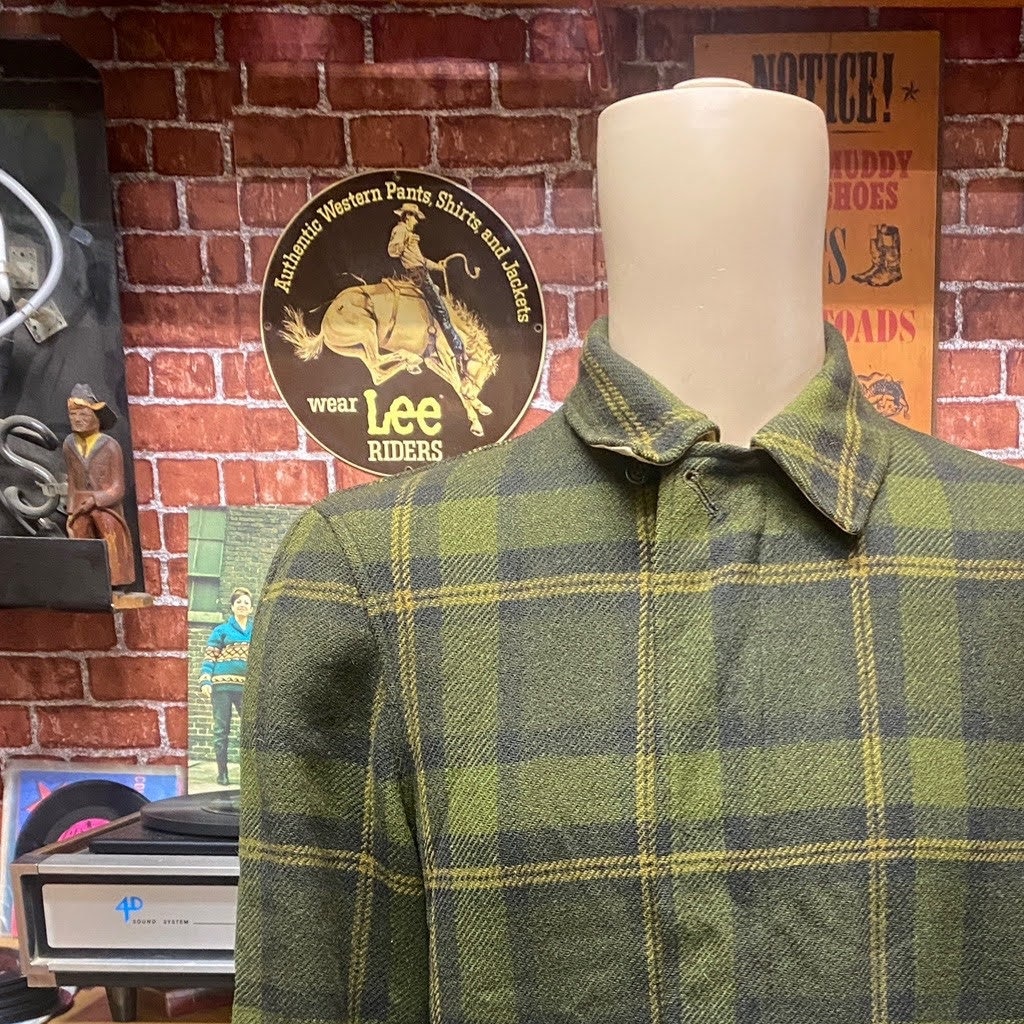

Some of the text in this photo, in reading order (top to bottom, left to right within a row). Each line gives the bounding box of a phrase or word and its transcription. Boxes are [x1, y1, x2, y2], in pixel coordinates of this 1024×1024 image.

[752, 51, 895, 124] NOTICE!
[828, 181, 899, 211] HOES
[273, 180, 530, 324] Authentic Western Pants, Shirts, and Jackets
[306, 389, 443, 437] wear Lee
[367, 439, 444, 462] RIDERS
[114, 895, 145, 924] 4D
